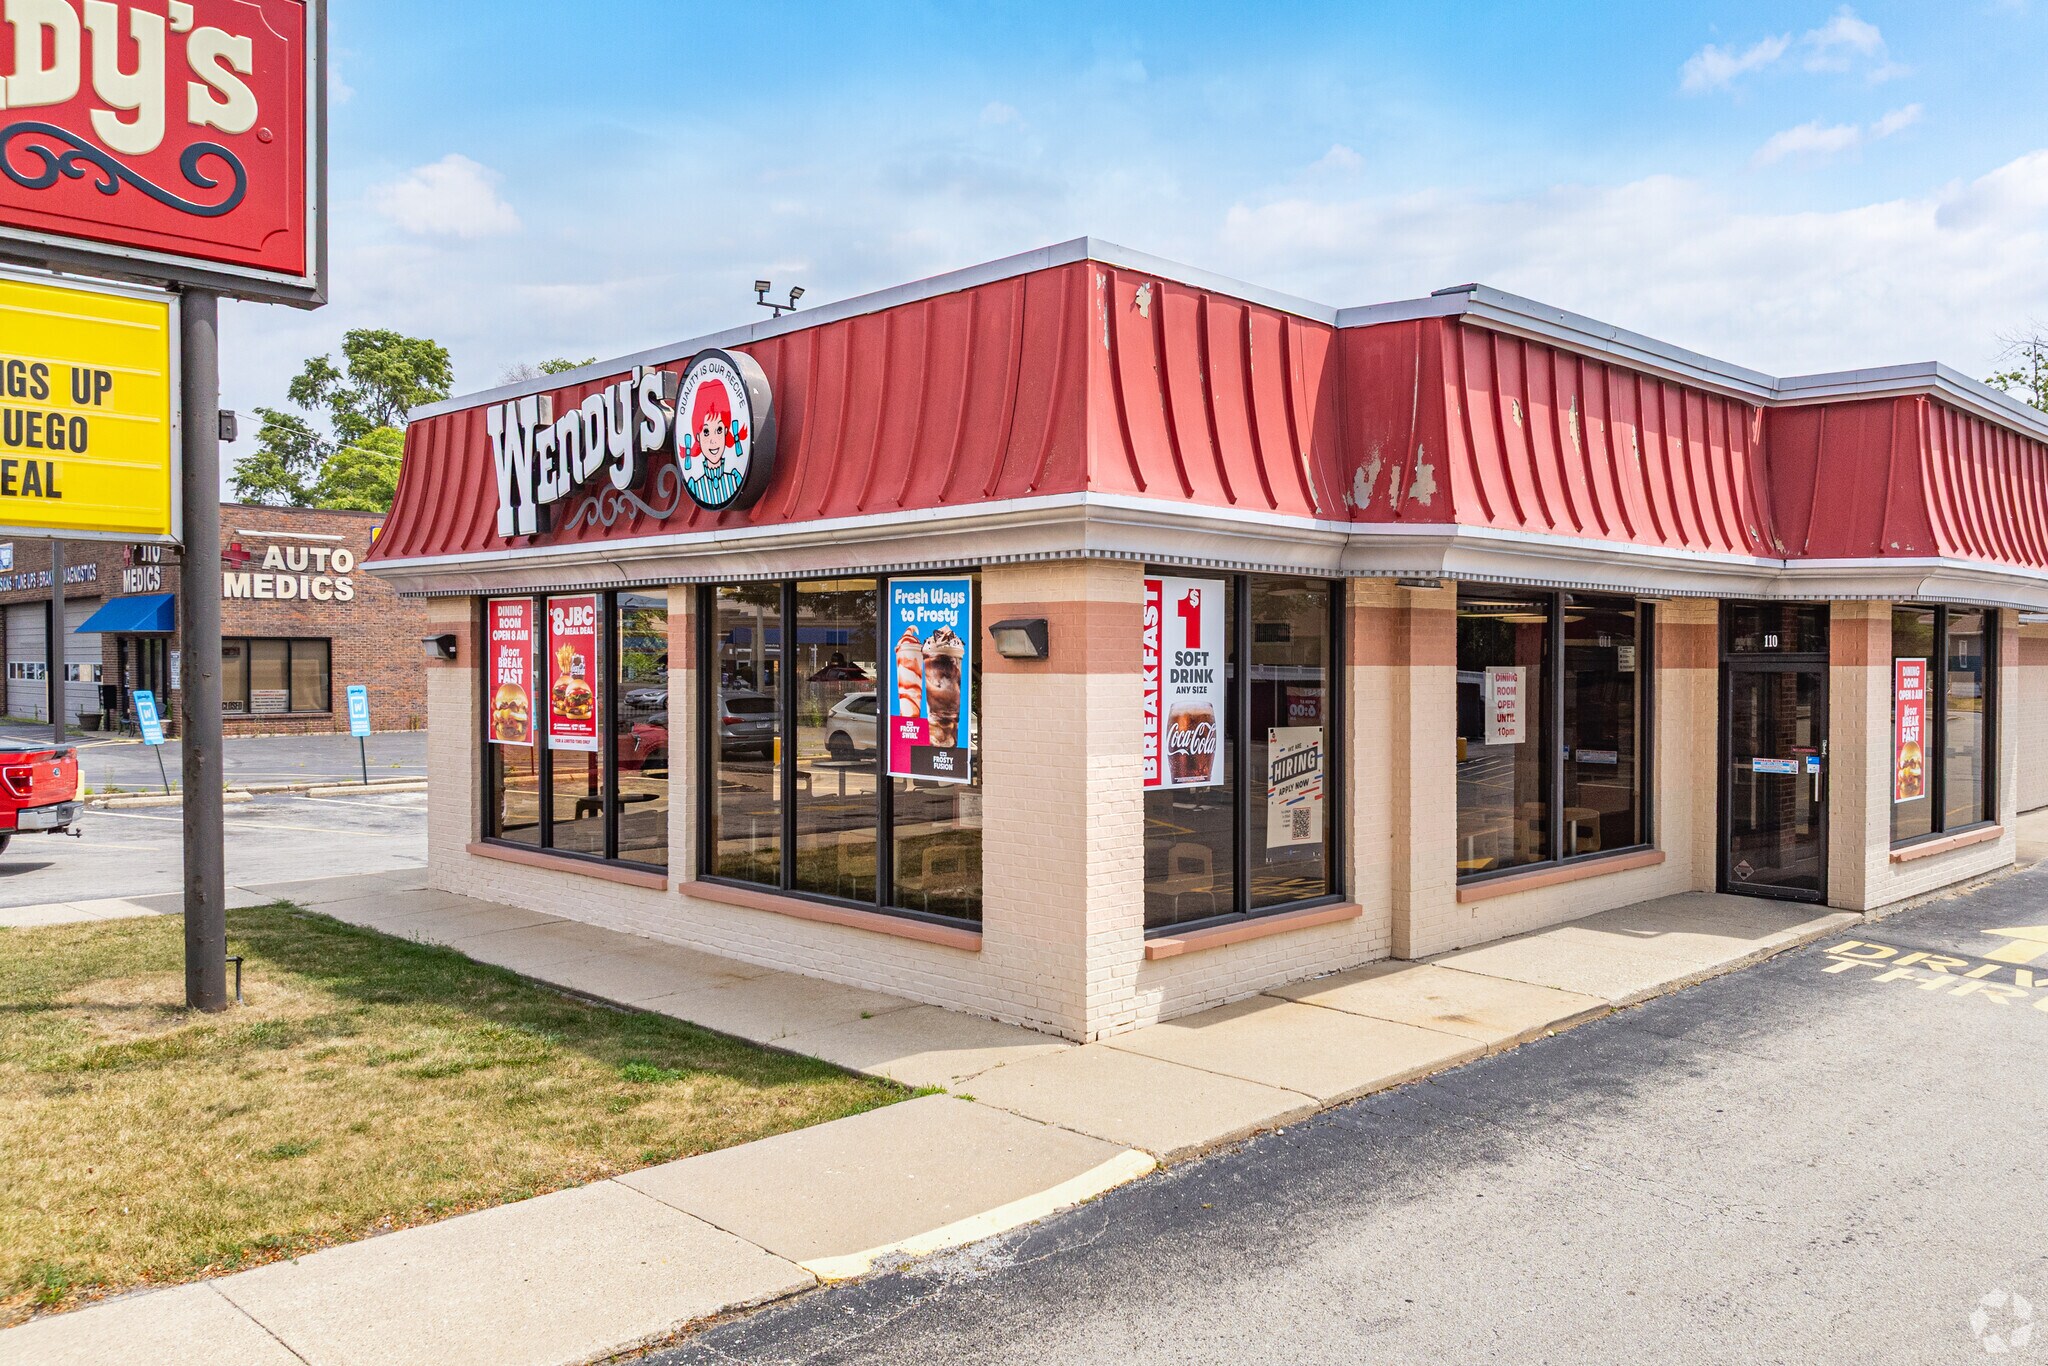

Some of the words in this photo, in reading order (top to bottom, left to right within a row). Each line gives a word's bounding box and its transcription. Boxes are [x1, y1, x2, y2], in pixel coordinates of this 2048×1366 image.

[0, 359, 50, 400] GS
[72, 367, 113, 406] UP
[680, 371, 699, 415] QUALITY
[700, 365, 708, 376] IS
[709, 363, 725, 376] OUR
[725, 371, 746, 409] RECIPE
[3, 408, 88, 454] UEGO
[487, 365, 669, 538] Wendy's
[1, 459, 63, 499] EAL
[261, 545, 355, 574] AUTO
[123, 565, 161, 594] MEDICS
[223, 572, 355, 601] MEDICS
[895, 587, 929, 605] Fresh
[930, 588, 966, 609] Ways
[497, 605, 523, 617] DINING
[564, 605, 594, 626] JBC
[901, 607, 915, 622] to
[917, 606, 959, 627] Frosty
[499, 618, 522, 629] ROOM
[492, 630, 511, 641] OPEN
[511, 630, 516, 641] 8
[517, 630, 528, 641] AM
[565, 627, 579, 635] MEAL
[580, 627, 594, 635] DEAL
[1764, 634, 1778, 648] 110
[508, 648, 520, 657] GOT
[1174, 651, 1209, 667] SOFT
[498, 657, 523, 668] BREAK
[498, 668, 523, 684] FAST
[1170, 668, 1214, 684] DRINK
[1495, 672, 1518, 682] DINING
[1902, 666, 1920, 677] DINING
[1144, 586, 1158, 779] BREAKFAST
[1903, 677, 1919, 688] ROOM
[1176, 686, 1191, 694] ANY
[1192, 686, 1207, 694] SIZE
[1496, 686, 1517, 696] ROOM
[1899, 689, 1911, 700] OPEN
[1497, 700, 1515, 709] OPEN
[1496, 713, 1516, 723] UNTIL
[1902, 716, 1919, 727] BREAK
[900, 725, 920, 733] FROSTY
[1497, 727, 1515, 737] 10pm
[1902, 727, 1920, 743] FAST
[1167, 722, 1216, 756] Coca-Cola
[933, 756, 954, 764] FROSTY
[933, 763, 953, 771] FUSION
[1274, 750, 1315, 782] HIRING
[1279, 784, 1294, 796] APPLY
[1295, 778, 1309, 790] NOW
